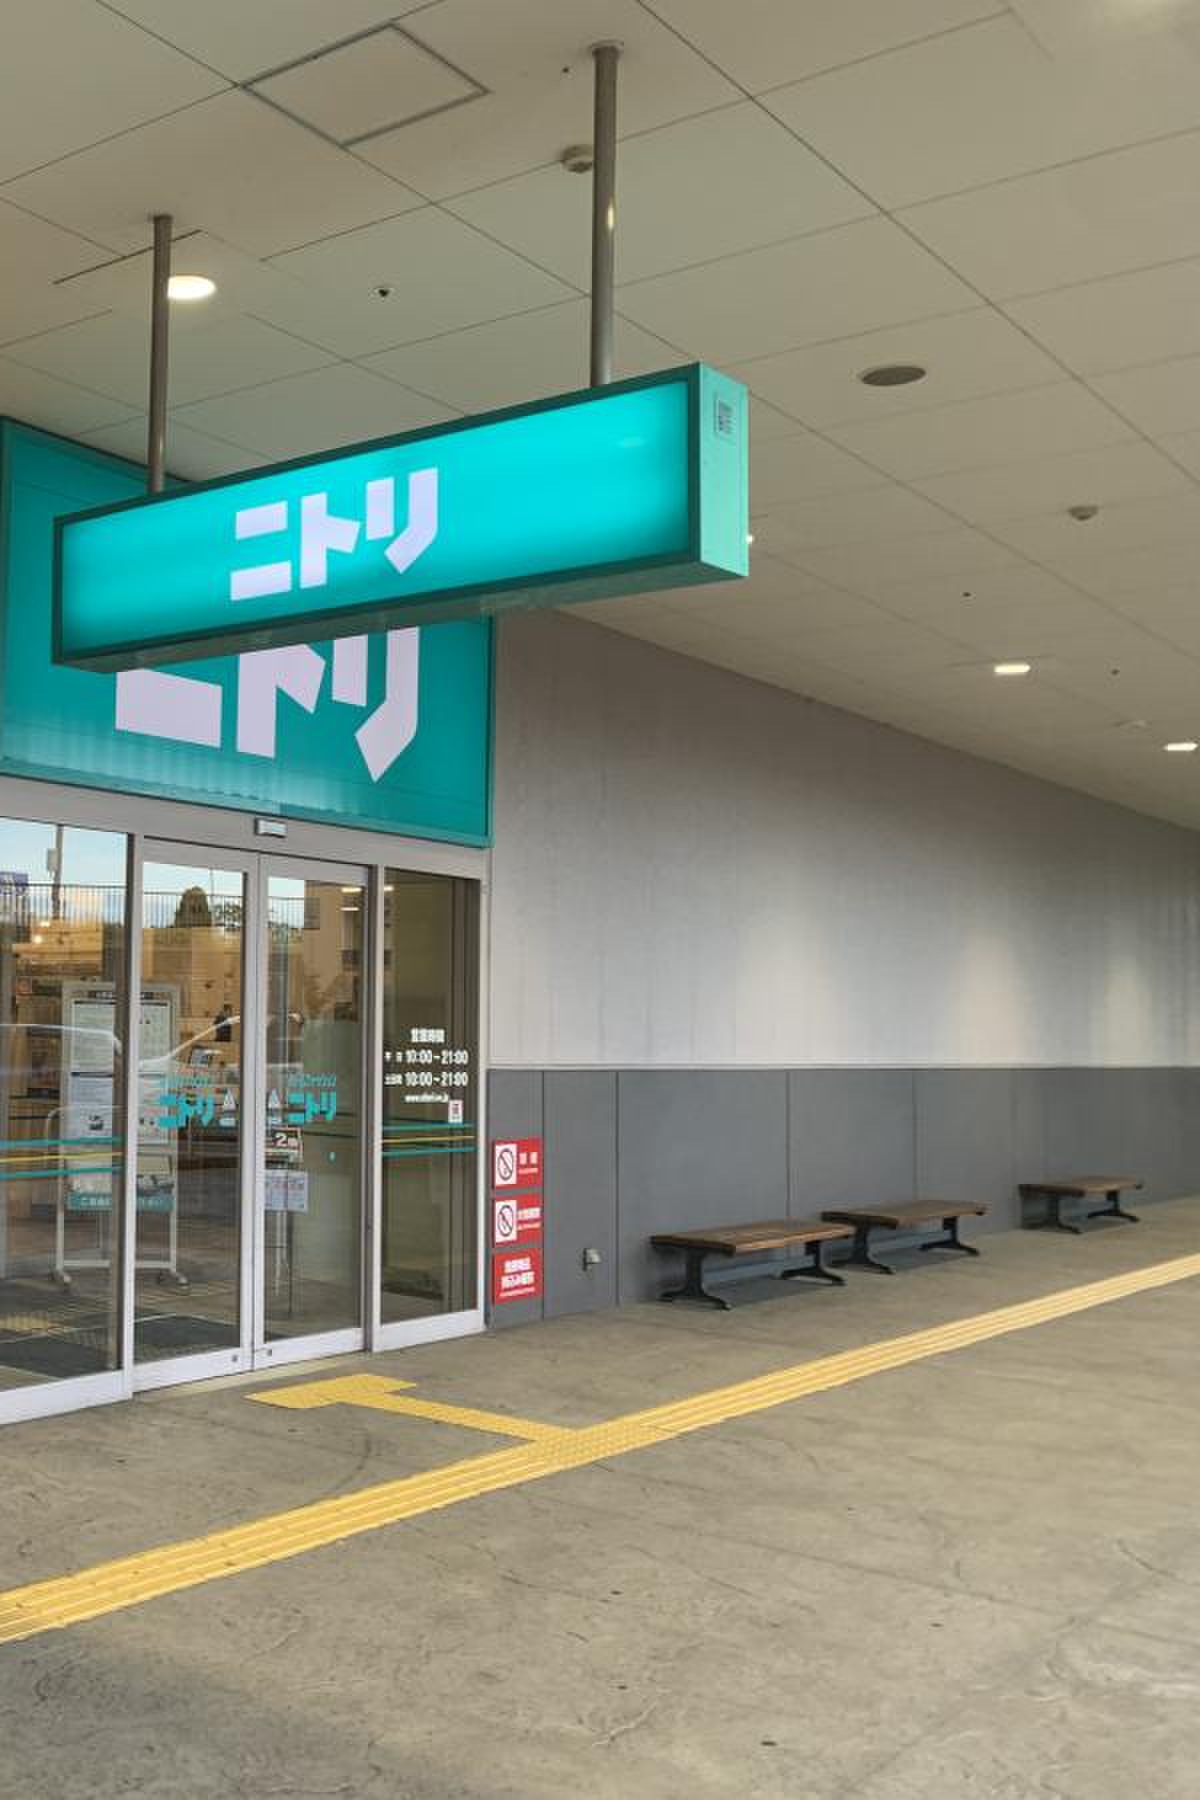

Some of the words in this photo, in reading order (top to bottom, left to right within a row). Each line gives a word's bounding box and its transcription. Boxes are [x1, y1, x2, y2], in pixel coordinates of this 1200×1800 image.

[229, 467, 440, 602] ニトリ
[286, 1090, 337, 1125] ニトリ
